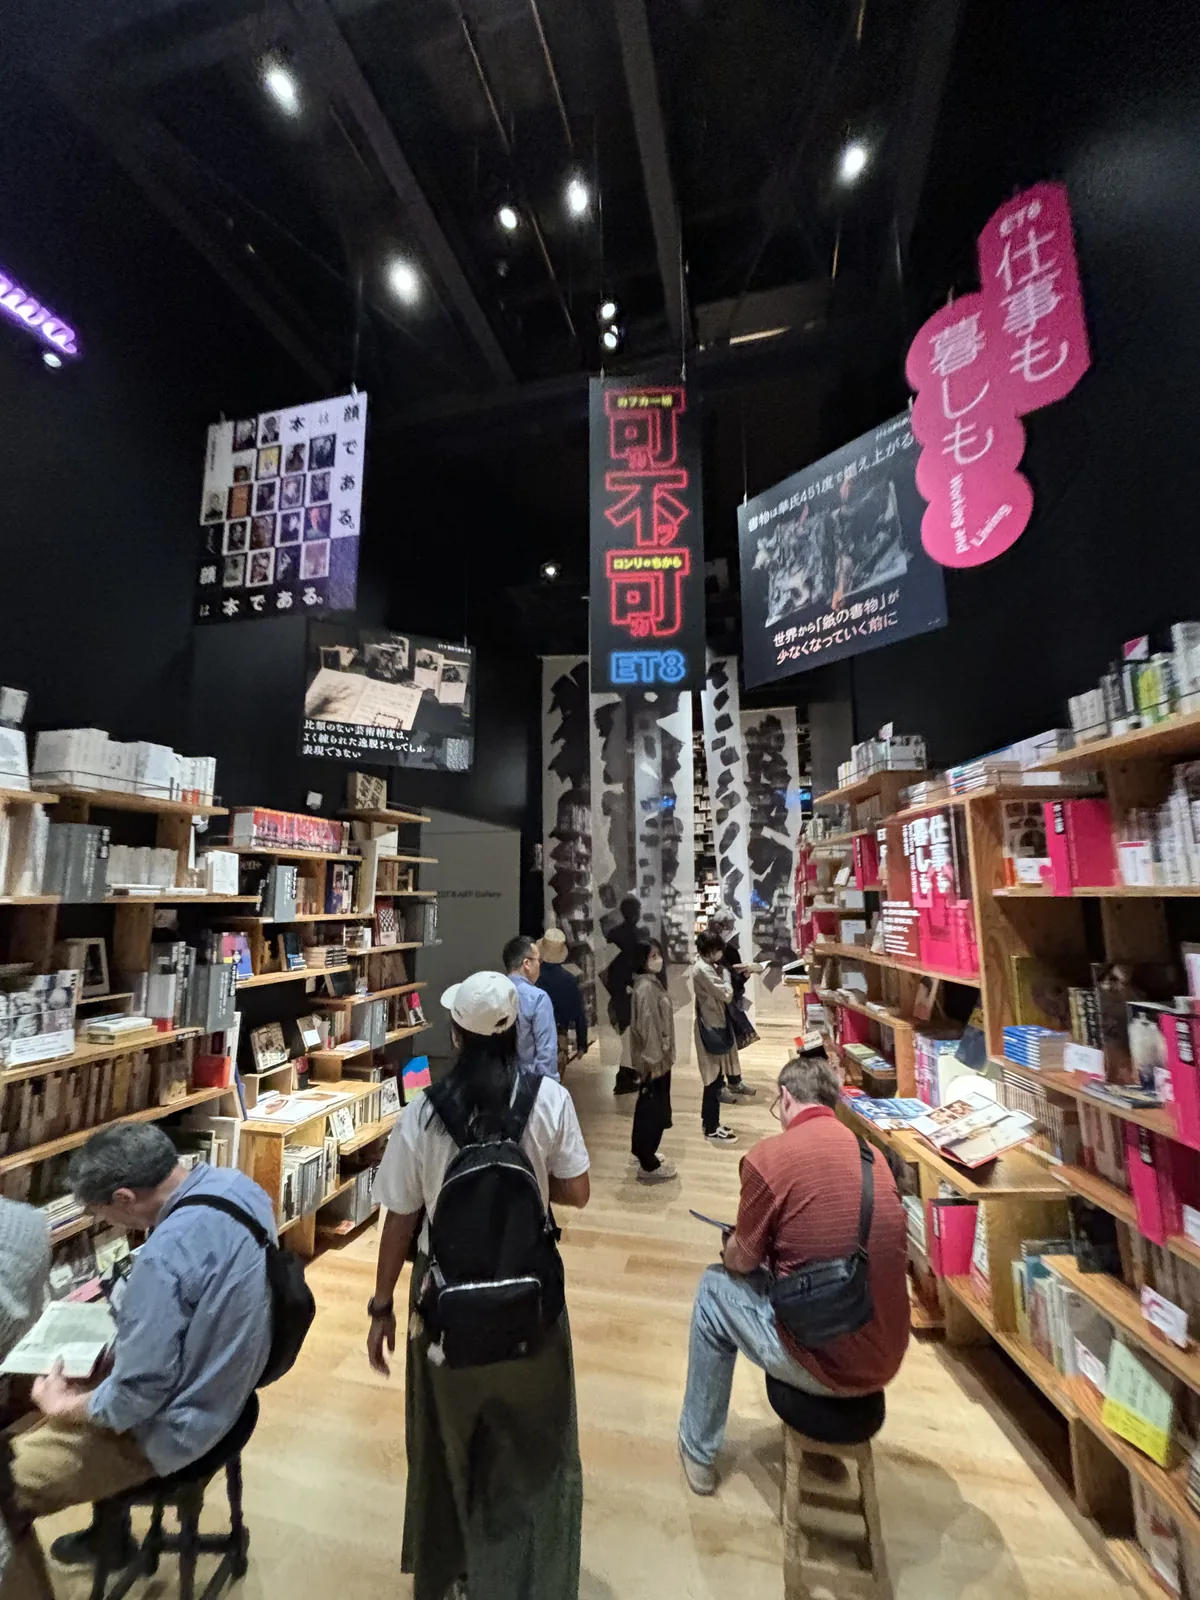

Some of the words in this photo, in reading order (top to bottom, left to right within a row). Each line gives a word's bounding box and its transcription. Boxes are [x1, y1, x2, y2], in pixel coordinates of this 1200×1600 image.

[996, 228, 1067, 383] 仕事も
[776, 610, 899, 666] 少なくなっていく前に
[610, 649, 687, 684] ET8
